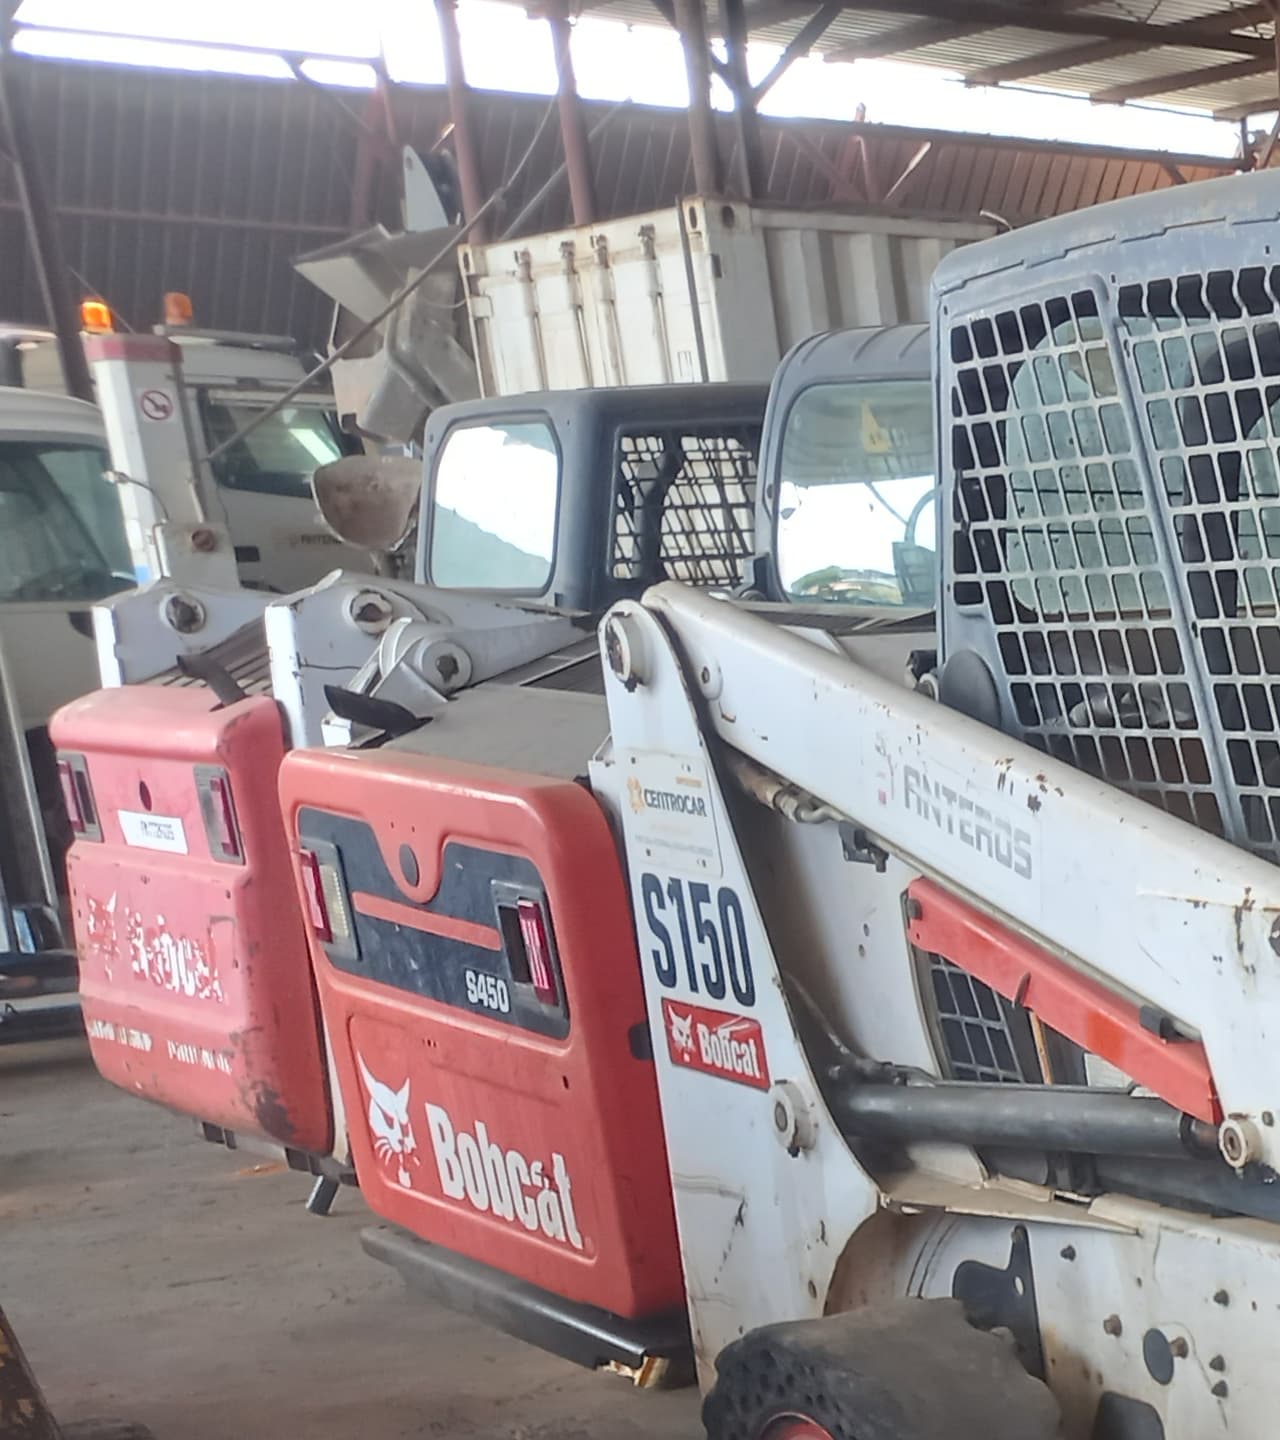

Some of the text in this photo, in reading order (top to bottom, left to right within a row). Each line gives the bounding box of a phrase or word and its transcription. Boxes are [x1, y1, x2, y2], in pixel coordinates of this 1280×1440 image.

[643, 788, 708, 817] CENTROCAR
[904, 765, 1032, 880] ANTEROS
[641, 873, 756, 1007] S150
[465, 970, 511, 1013] S450
[697, 1022, 761, 1079] Bobcat
[424, 1102, 583, 1250] Bobcat
